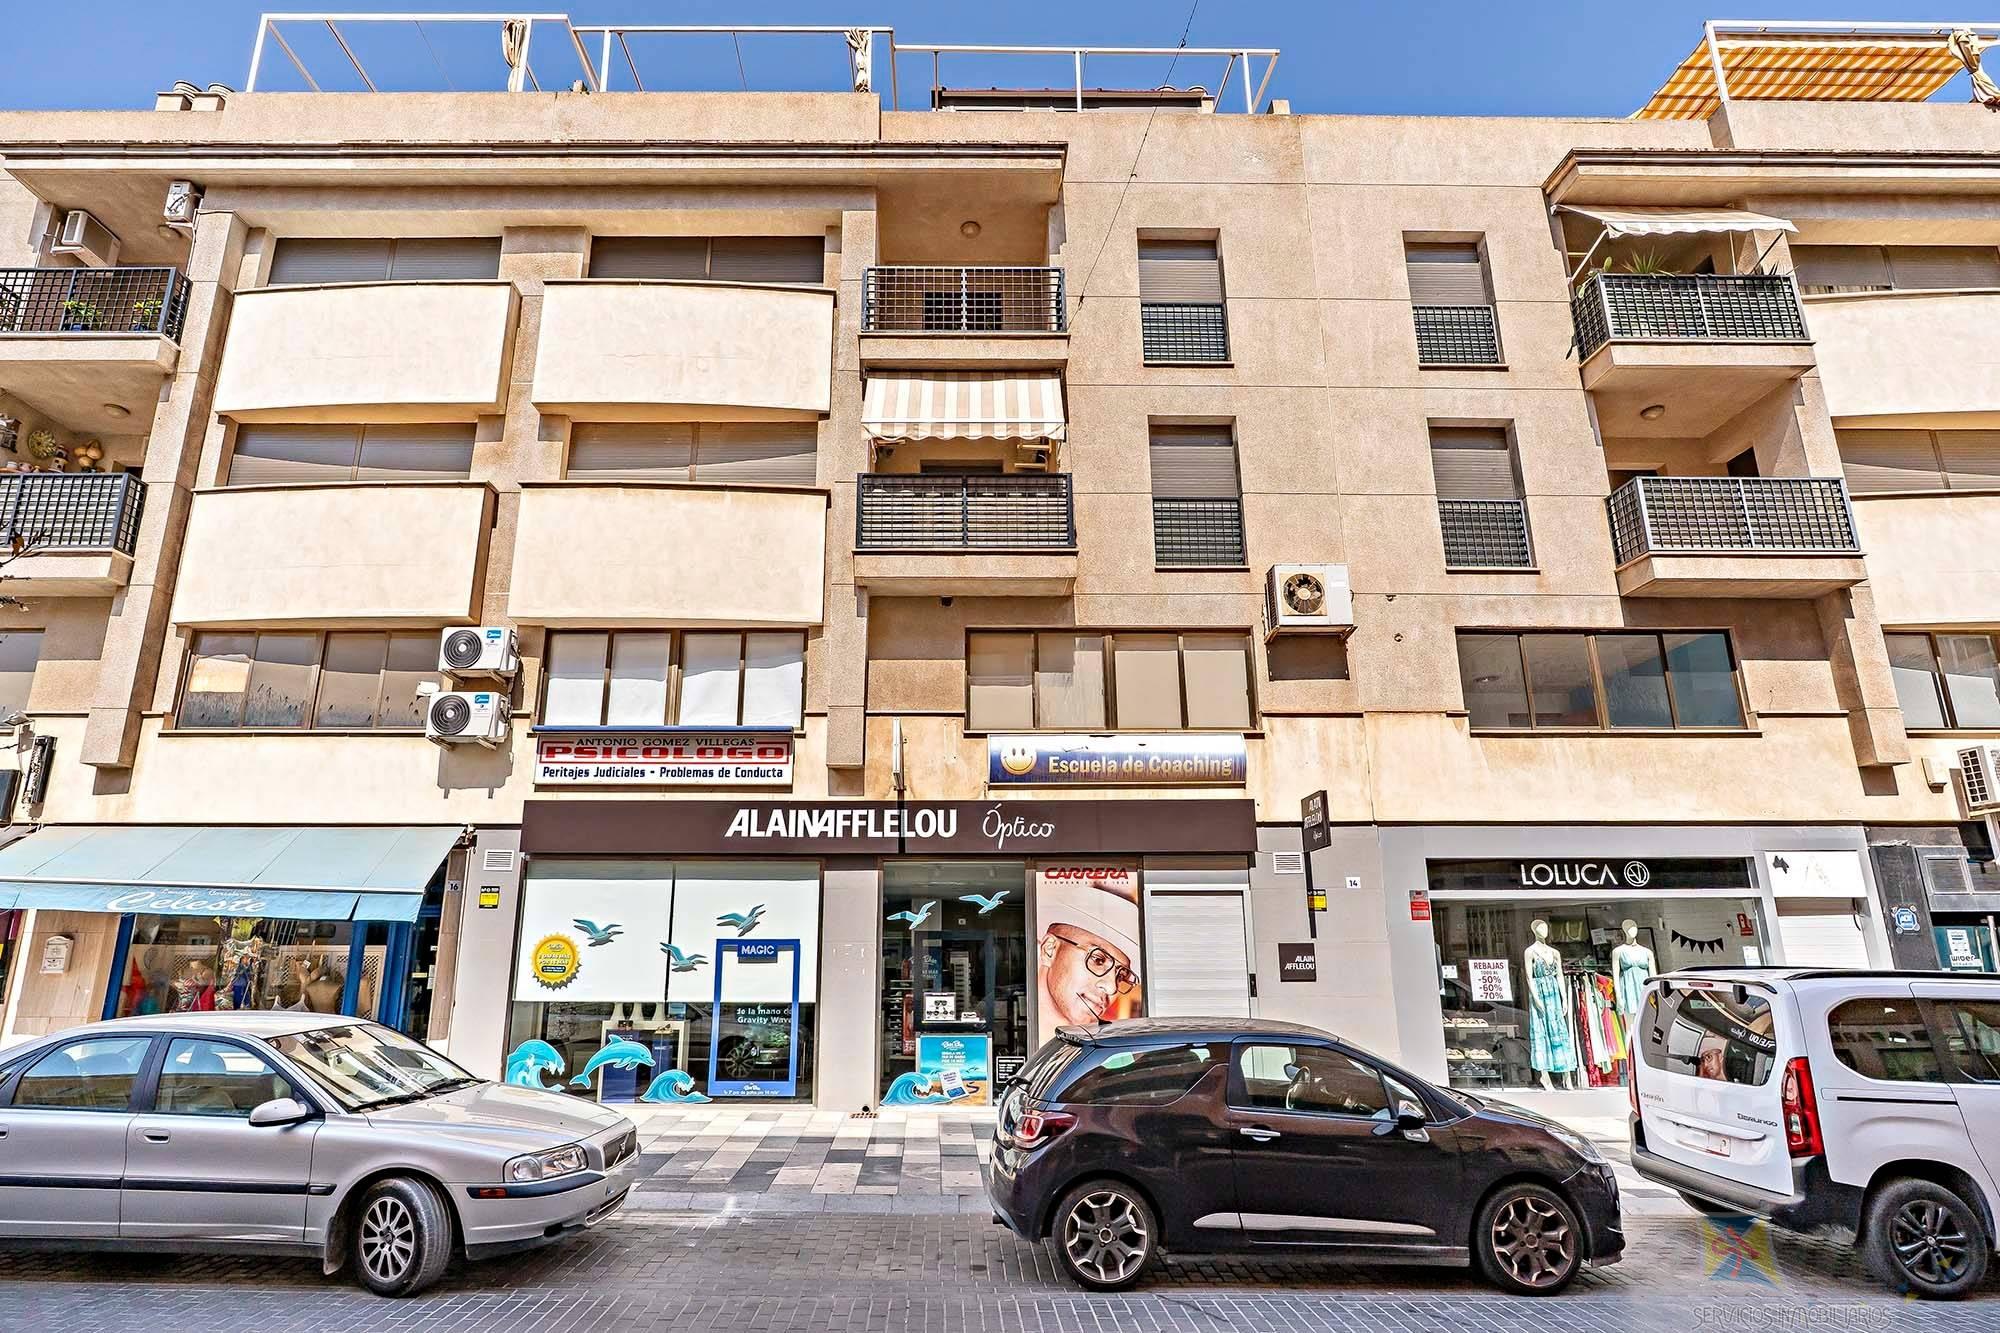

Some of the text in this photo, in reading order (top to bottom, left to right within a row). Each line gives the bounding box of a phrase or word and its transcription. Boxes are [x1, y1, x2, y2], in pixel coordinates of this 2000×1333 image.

[576, 738, 755, 746] ANTONIO GOMEZ VILLEGAS
[545, 746, 784, 759] PSICOLOGO
[1048, 755, 1233, 776] Escuela de Coaching
[542, 766, 590, 780] Peritajes
[593, 766, 646, 778] Judiciales
[659, 766, 714, 778] Problemas
[718, 766, 731, 778] de
[735, 766, 784, 778] Conducta
[982, 802, 1055, 850] Óptico
[1044, 867, 1129, 880] CARRERA
[1521, 864, 1618, 886] LOLUCA
[450, 883, 459, 891] 16
[1349, 880, 1358, 888] 14
[105, 891, 268, 914] Celeste
[741, 945, 775, 955] MAGIC
[1284, 962, 1315, 970] AFFLELOU
[737, 1016, 768, 1025] Gravity
